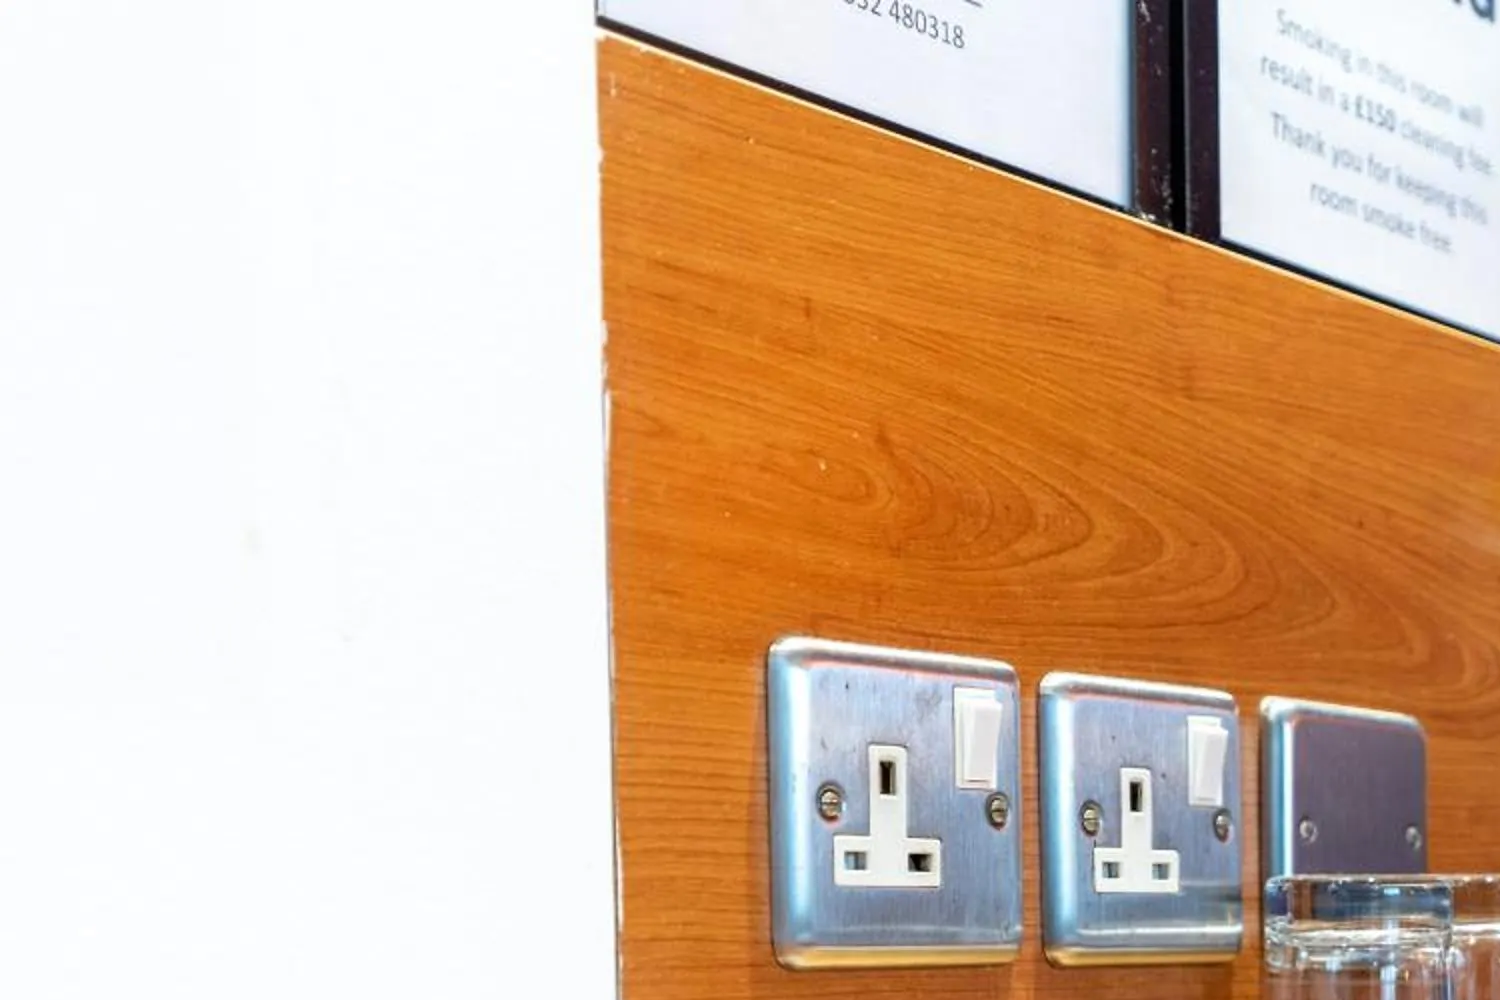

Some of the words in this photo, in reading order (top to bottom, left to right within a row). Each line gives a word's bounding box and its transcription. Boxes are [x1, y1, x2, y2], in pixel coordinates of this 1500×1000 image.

[888, 0, 966, 49] 480318
[1275, 8, 1352, 73] Smoking
[1260, 55, 1313, 96] result
[1318, 74, 1335, 105] in
[1340, 91, 1350, 112] a
[1355, 93, 1397, 132] £150
[1270, 110, 1326, 157] Thank
[1331, 144, 1364, 174] you
[1367, 152, 1392, 183] for
[1310, 182, 1358, 216] room
[1361, 203, 1416, 240] smoke
